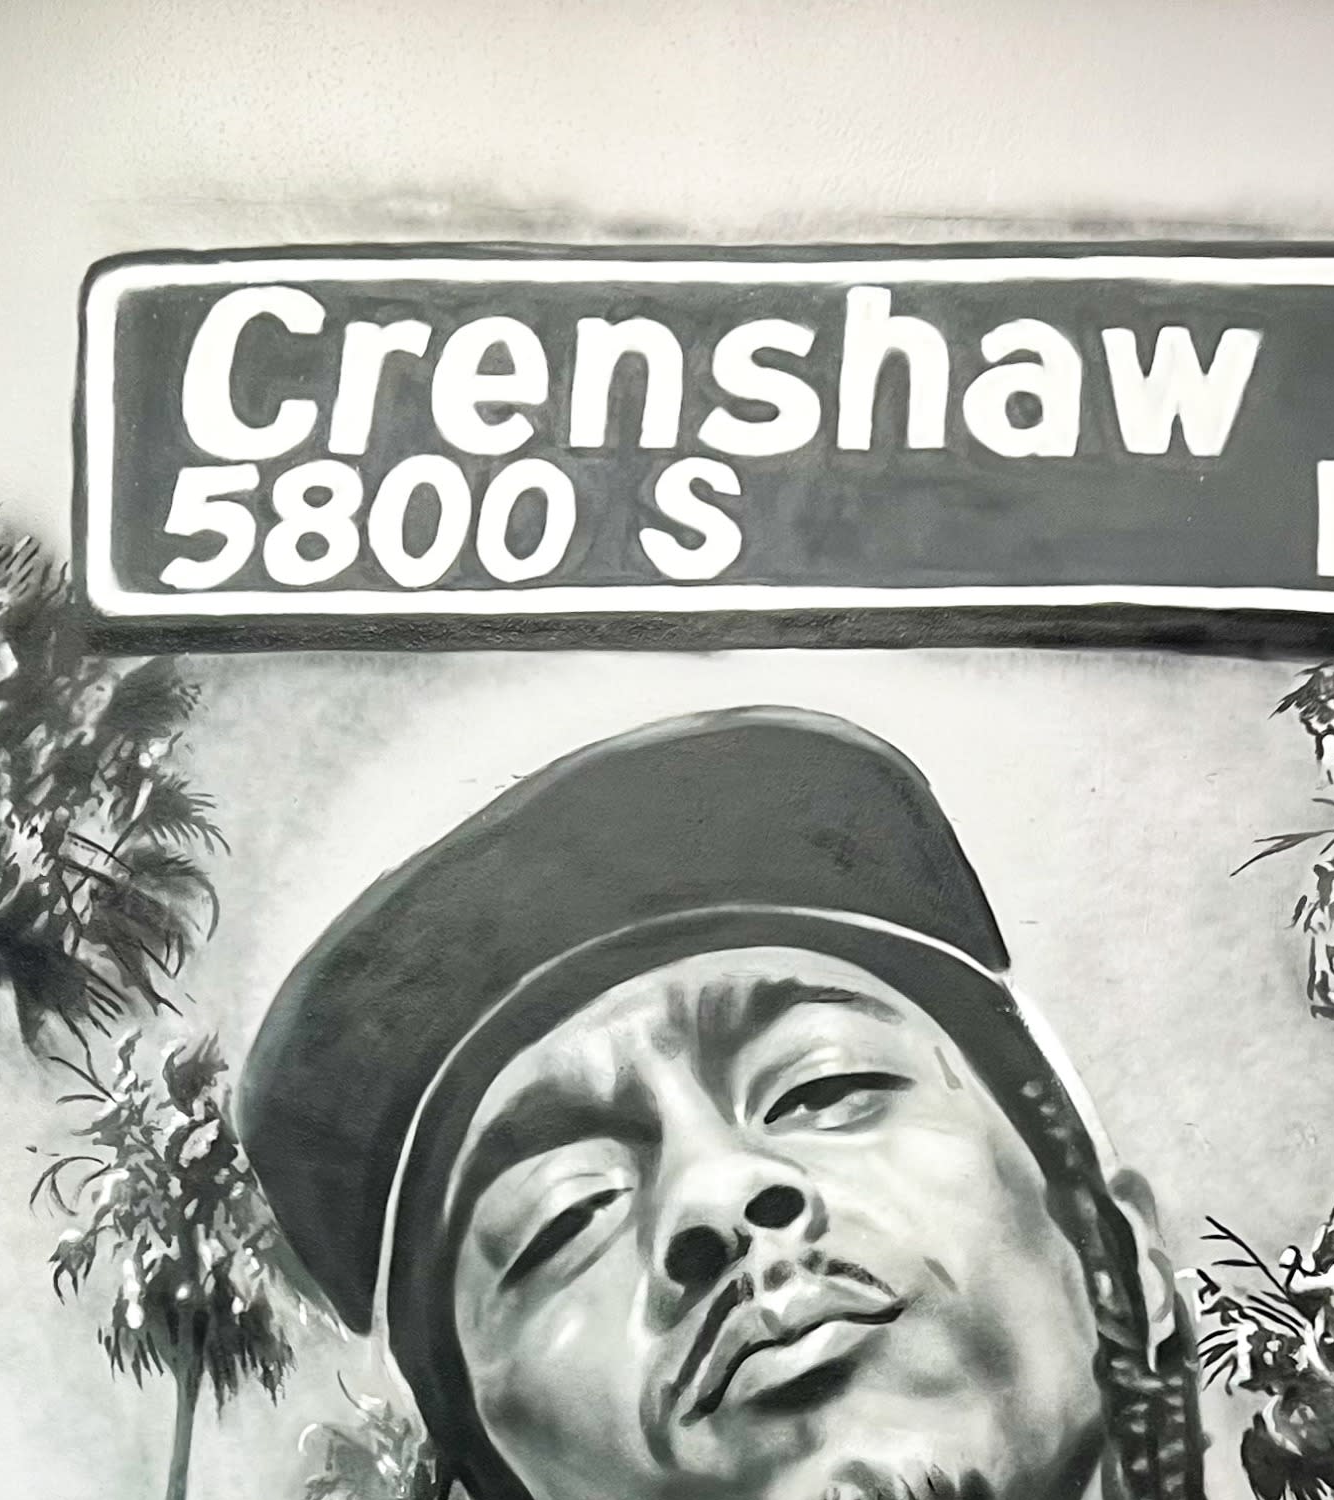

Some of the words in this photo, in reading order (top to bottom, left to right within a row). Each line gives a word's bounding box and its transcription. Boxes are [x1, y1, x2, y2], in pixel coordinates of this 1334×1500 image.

[182, 286, 1261, 461] Crenshaw
[159, 457, 576, 590] 5800
[639, 457, 742, 581] S
